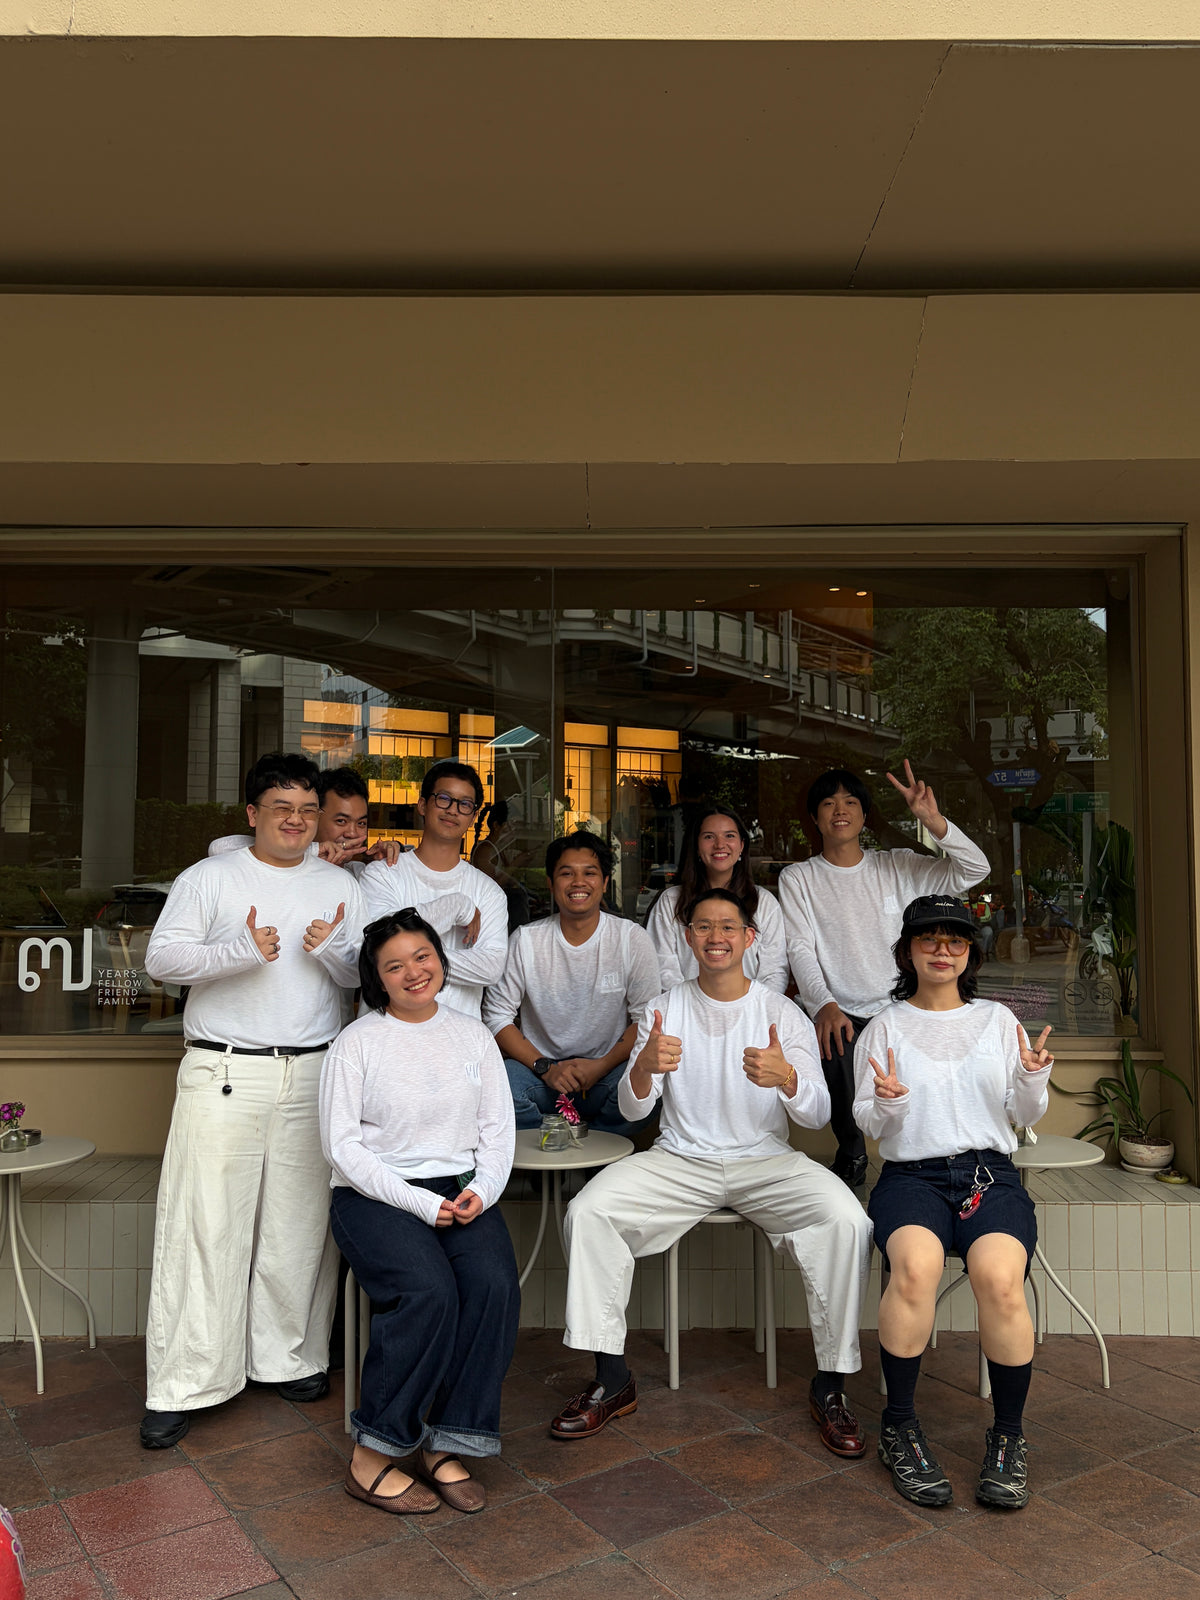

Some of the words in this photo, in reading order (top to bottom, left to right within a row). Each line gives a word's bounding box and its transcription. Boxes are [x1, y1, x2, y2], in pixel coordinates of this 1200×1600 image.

[98, 969, 137, 978] YEARS
[98, 979, 142, 987] FELLOW
[98, 988, 138, 996] FRIEND
[98, 997, 137, 1006] FAMILY
